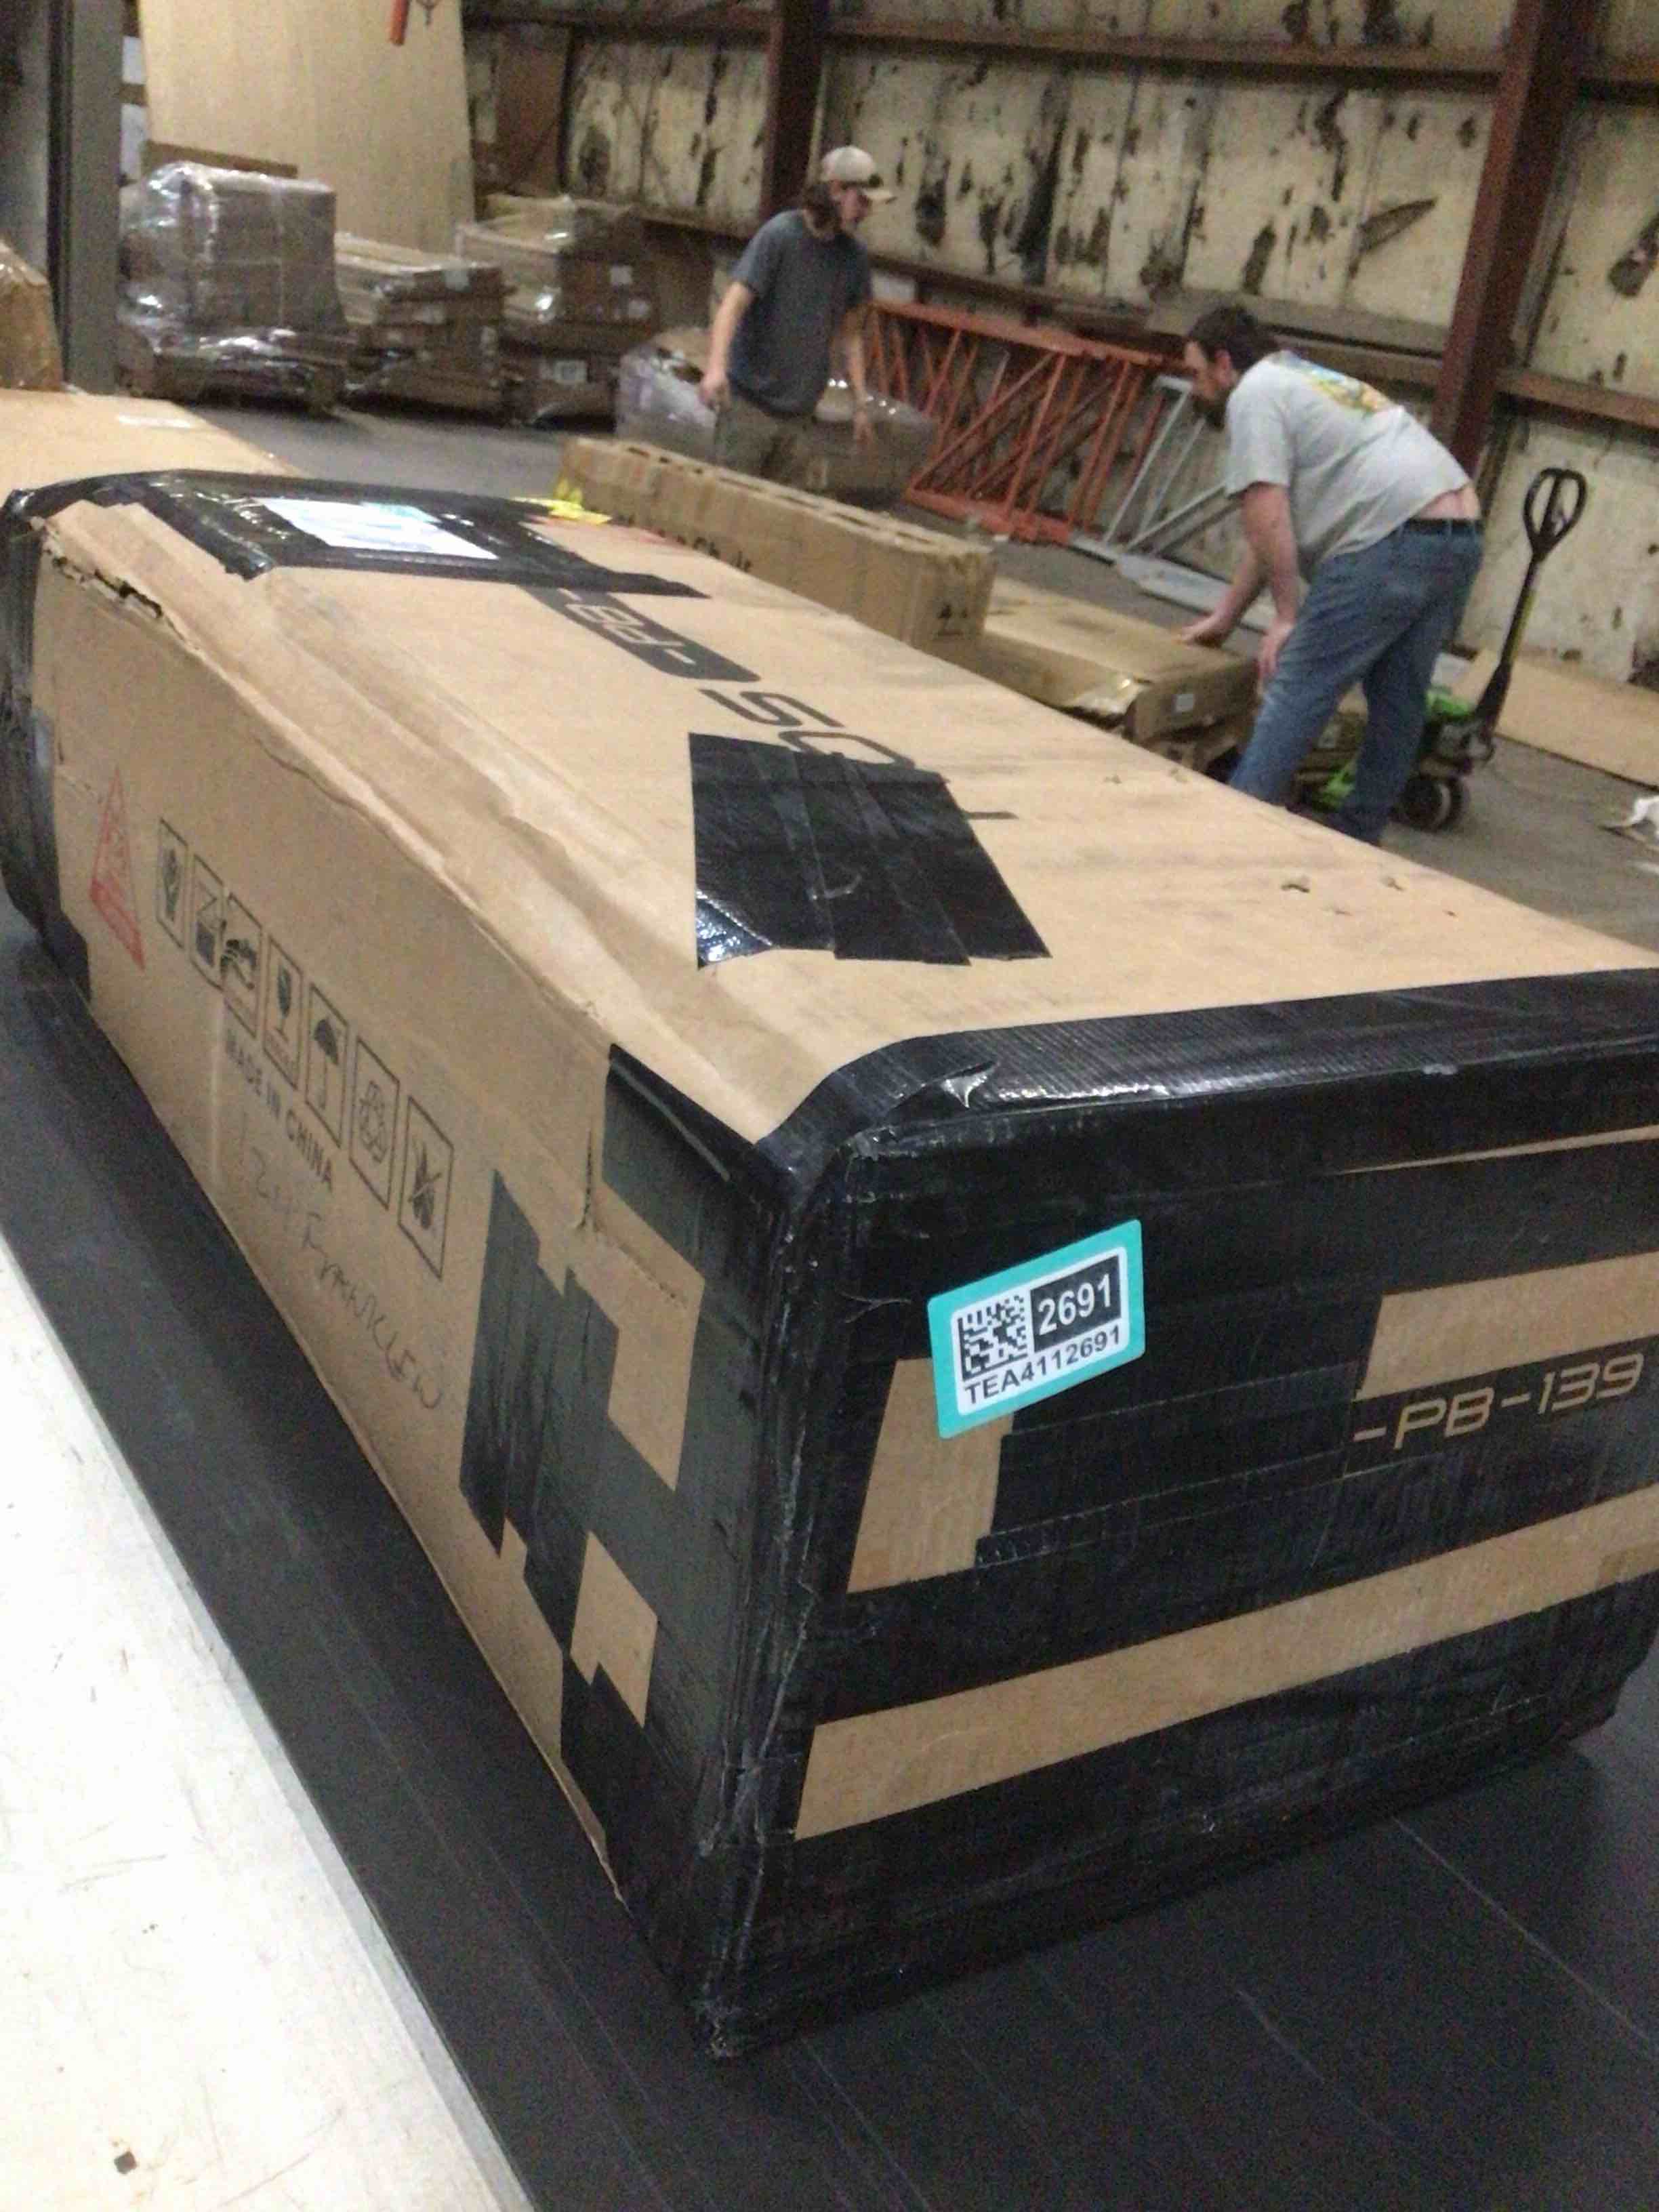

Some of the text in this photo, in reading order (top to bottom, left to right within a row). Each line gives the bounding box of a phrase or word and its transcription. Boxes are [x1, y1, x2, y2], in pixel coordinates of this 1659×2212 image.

[226, 1028, 333, 1191] MADE IN CHINA
[1038, 1273, 1111, 1336] 2691
[964, 1325, 1120, 1405] TEA4112691
